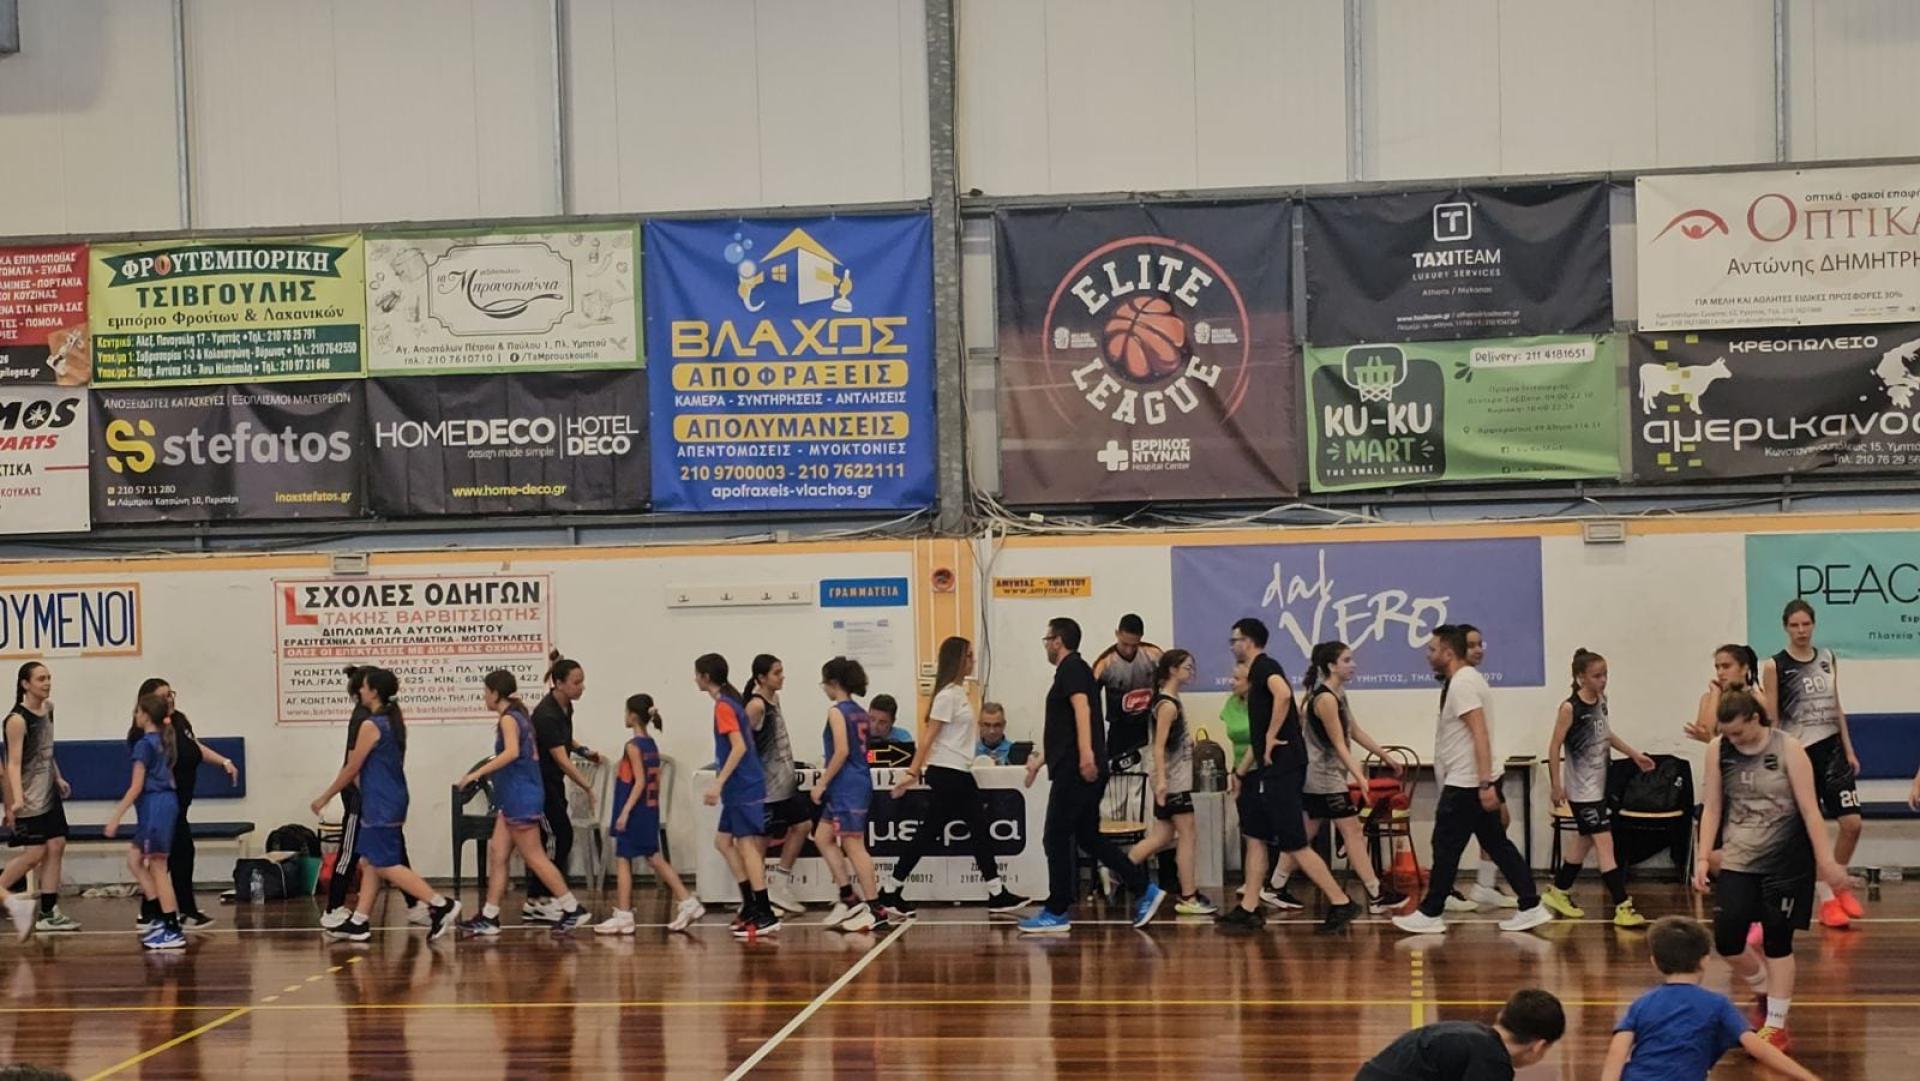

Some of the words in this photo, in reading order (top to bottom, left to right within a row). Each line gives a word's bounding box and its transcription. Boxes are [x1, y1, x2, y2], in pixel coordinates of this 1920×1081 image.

[1805, 192, 1842, 202] οπτικά
[1851, 189, 1884, 203] φακοί
[121, 249, 330, 279] ΦΡΟΥΤΕΜΠΟΡΙΚΗ
[1412, 249, 1501, 268] TAXITEAM
[1727, 257, 1814, 276] Αντώνης
[1412, 271, 1449, 281] LUXURY
[1454, 268, 1501, 278] SERVICES
[1070, 254, 1213, 316] ELITE
[136, 280, 317, 309] ΤΣΙΒΓΟΥΛΗΣ
[107, 312, 167, 330] εμπόριο
[172, 308, 239, 327] Φρούτων
[245, 309, 257, 321] &
[263, 304, 344, 323] Λαχανικών
[1729, 335, 1878, 353] ΚΡΕΟΠΩΛΕΙΟ
[1475, 351, 1521, 363] Delivery:
[688, 364, 891, 387] ΑΠΟΦΡΑΞΕΙΣ
[675, 394, 725, 407] ΚΑΜΕΡΑ
[737, 392, 823, 406] ΣΥΝΤΗΡΗΣΕΙΣ
[835, 391, 907, 405] ΑΝΤΛΗΣΕΙΣ
[1071, 356, 1222, 425] LEAGUE
[687, 415, 895, 439] ΑΠΟΛΥΜΑΝΣΕΙΣ
[1324, 402, 1433, 438] KU-KU
[376, 417, 556, 448] HOMEDECO
[567, 415, 639, 435] HOTEL
[163, 421, 351, 466] stefatos
[567, 436, 631, 456] DECO
[677, 444, 791, 458] ΑΠΕΝΤΟΜΩΣΕΙΣ
[809, 442, 907, 457] ΜΥΟΚΤΟΝΙΕΣ
[1132, 439, 1190, 451] ΕΡΡΙΚΟΣ
[1346, 437, 1416, 464] MART
[467, 447, 496, 460] design
[498, 446, 523, 458] made
[526, 446, 555, 460] simple
[1132, 450, 1191, 463] ΝΤΥΝΑΝ
[1855, 454, 1874, 464] 210
[1876, 454, 1890, 464] 76
[1892, 454, 1905, 464] 29
[680, 466, 710, 481] 210
[714, 465, 786, 480] 9700003
[798, 464, 829, 479] 210
[834, 463, 905, 478] 7622111
[1352, 467, 1385, 476] SMALL
[118, 486, 134, 495] 210
[135, 486, 145, 494] 57
[452, 483, 567, 497] www.home-deco.gr
[711, 483, 874, 500] apofraxeis-vlachos.gr
[829, 586, 899, 598] ΓΡΑΜΜΑΤΕΙΑ
[1797, 563, 1920, 605] PEAC
[305, 584, 413, 609] ΣΧΟΛΕΣ
[425, 581, 540, 606] ΟΔΗΓΩΝ
[324, 610, 389, 625] ΤΑΚΗΣ
[397, 607, 540, 623] ΒΑΡΒΙΤΣΙΩΤΗΣ
[322, 626, 401, 637] ΔΙΠΛΩΜΑΤΑ
[407, 624, 504, 635] ΑΥΤΟΚΙΝΗΤΟΥ
[284, 637, 356, 647] ΕΡΑΣΙΤΕΧΝΙΚΑ
[371, 635, 454, 646] ΕΠΑΓΓΕΛΜΑΤΙΚΑ
[461, 633, 542, 643] ΜΟΤΟΣΥΚΛΕΤΕΣ
[1803, 676, 1826, 693] 20
[300, 696, 351, 705] ΚΩΝΣΤΑΝΤ
[1840, 790, 1860, 808] 20
[1781, 897, 1794, 918] 4
